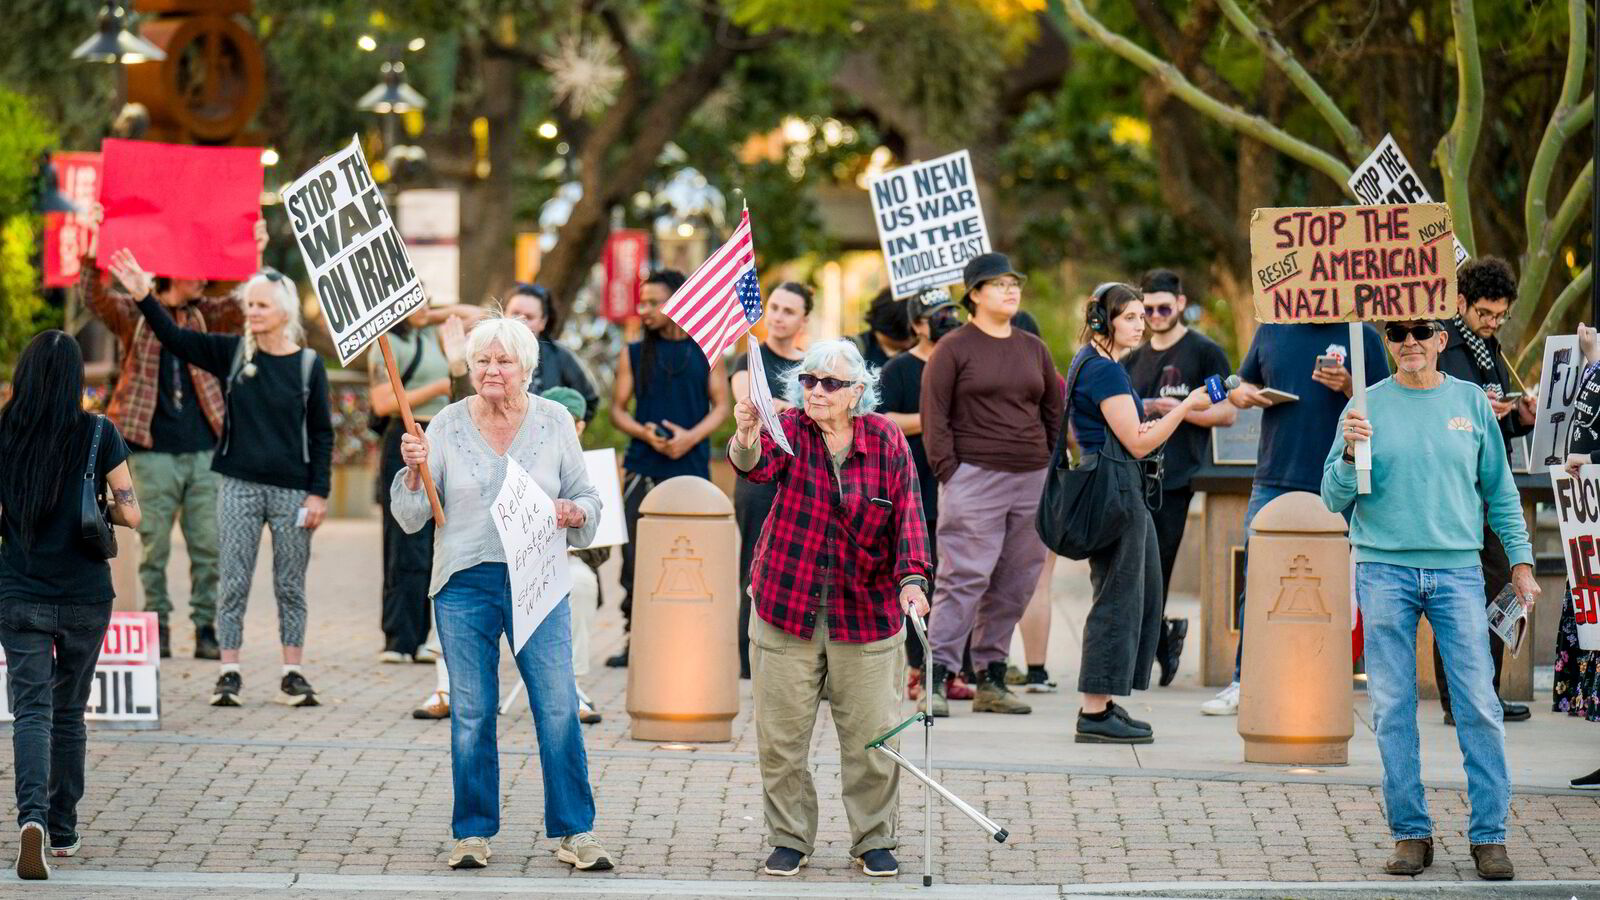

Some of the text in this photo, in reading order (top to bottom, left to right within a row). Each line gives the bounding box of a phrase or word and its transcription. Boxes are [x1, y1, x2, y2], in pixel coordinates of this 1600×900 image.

[288, 149, 372, 233] STOP TH
[874, 157, 968, 210] NO NEW
[1353, 143, 1407, 205] STOP THE
[1380, 173, 1424, 205] AR
[881, 189, 976, 232] US WAR
[1273, 207, 1410, 249] STOP THE
[1418, 217, 1447, 241] NOW
[887, 216, 981, 257] IN THE
[318, 226, 416, 334] ON IRAN!
[892, 236, 985, 281] MIDDLE EAST
[1257, 251, 1299, 288] RESIST
[1309, 247, 1440, 282] AMERICAN
[1272, 277, 1447, 320] NAZI PARTY!
[340, 286, 424, 358] PSLWEB.ORG
[1546, 347, 1579, 409] FU
[521, 502, 541, 535] the
[515, 515, 555, 571] Epstein
